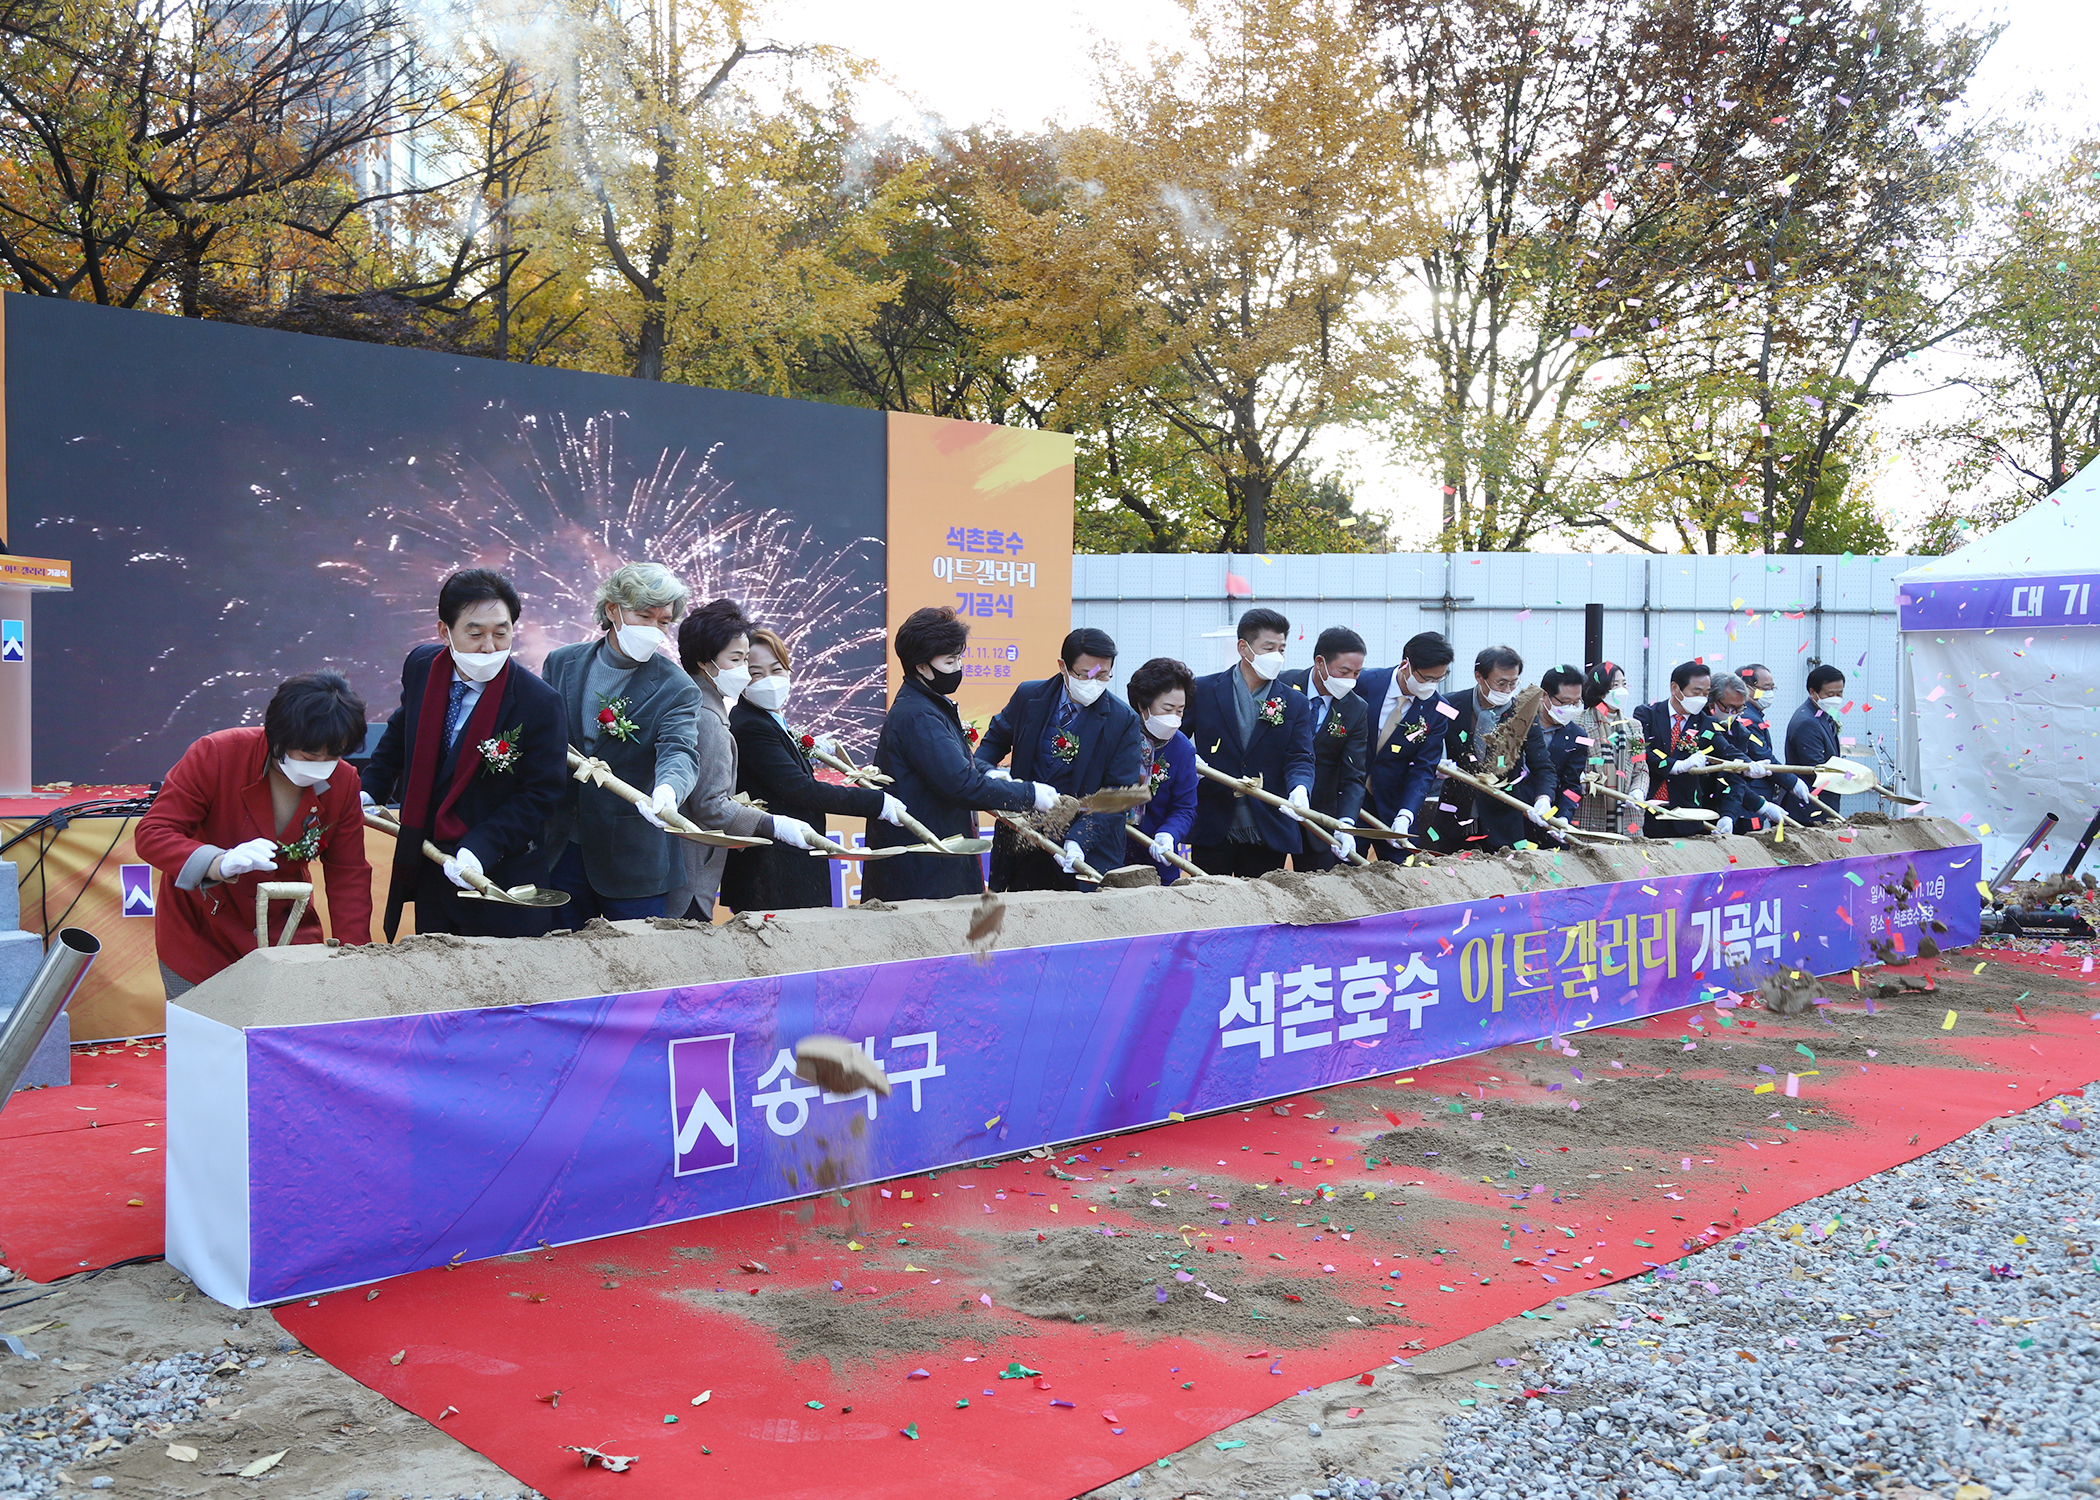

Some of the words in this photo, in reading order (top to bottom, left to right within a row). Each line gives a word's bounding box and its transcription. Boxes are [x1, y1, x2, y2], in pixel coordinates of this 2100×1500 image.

[946, 526, 1024, 556] 석촌호수
[932, 556, 1036, 588] 아트갤러리
[955, 592, 1014, 619] 기공식
[993, 664, 1011, 678] 동호
[1219, 951, 1440, 1060] 석촌호수
[1459, 908, 1677, 1013] 아트갤러리
[1691, 898, 1782, 973] 기공식
